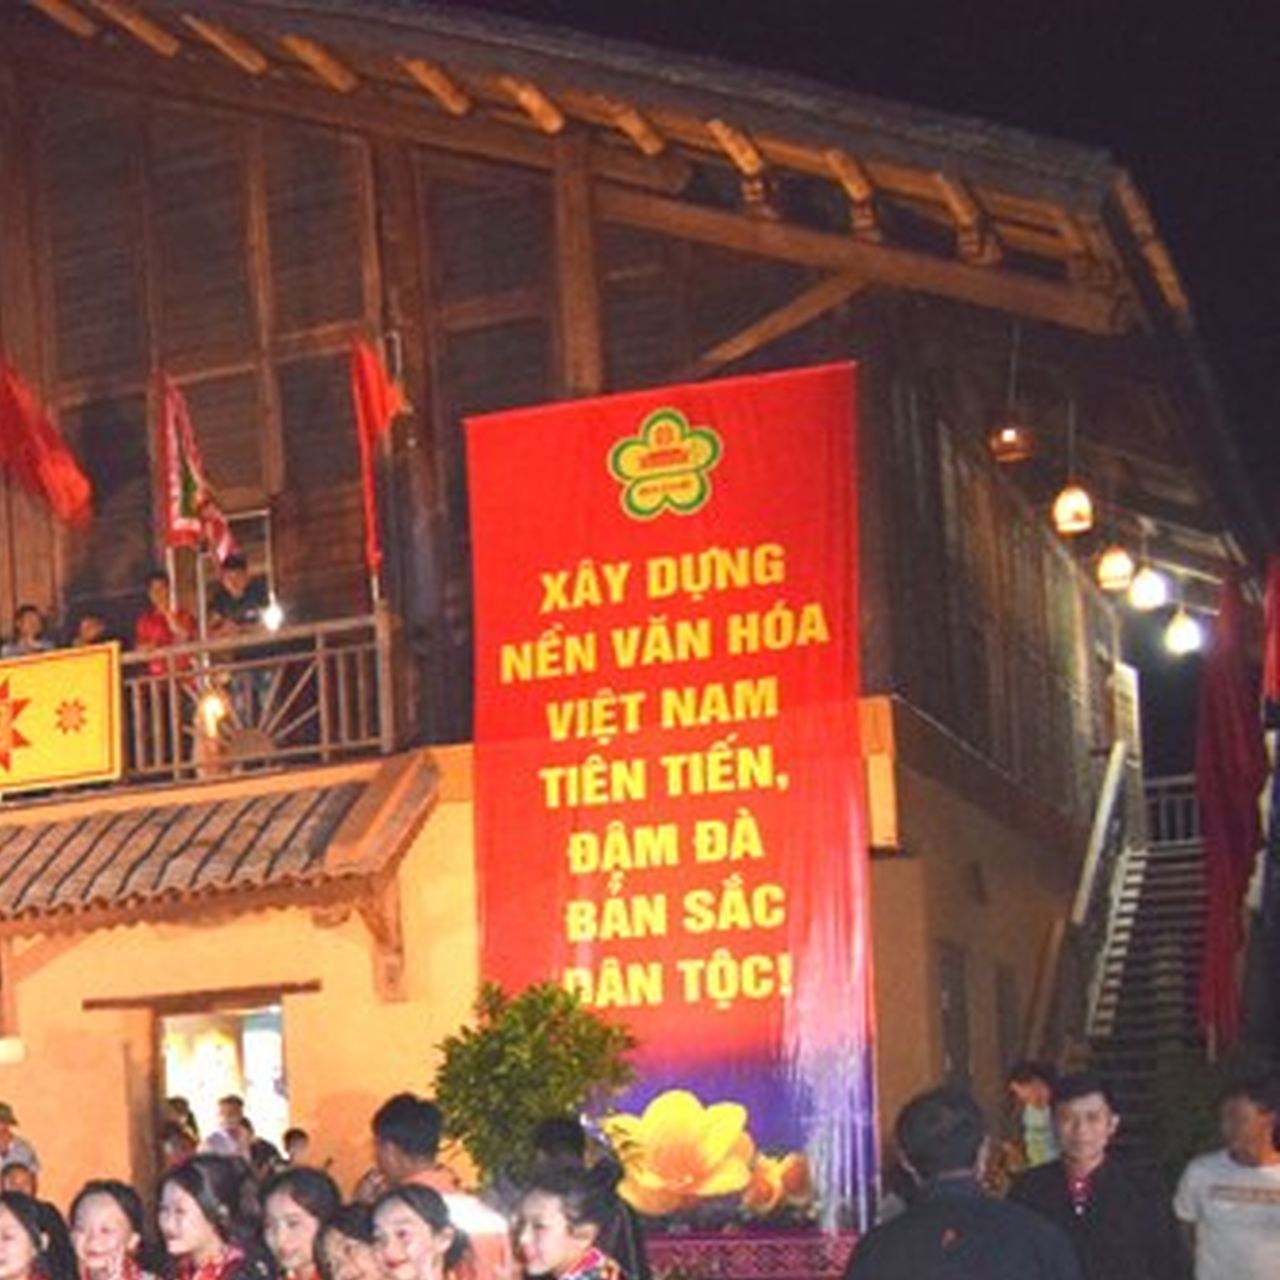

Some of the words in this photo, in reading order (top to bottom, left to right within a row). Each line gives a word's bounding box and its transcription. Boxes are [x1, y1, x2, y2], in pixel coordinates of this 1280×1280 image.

[540, 558, 631, 614] XÂY
[647, 543, 786, 602] DỰNG
[500, 622, 596, 684] NỀN
[611, 614, 711, 668] VĂN
[728, 599, 830, 655] HÓA
[546, 688, 646, 746] VIỆT
[661, 676, 778, 728] NAM
[539, 754, 646, 809] TIÊN
[660, 733, 789, 796] TIẾN,
[567, 820, 679, 877] ĐẬM
[694, 807, 765, 863] ĐÀ
[565, 878, 667, 943] BẢN
[683, 873, 785, 934] SẮC
[564, 957, 663, 1007] DÂN
[677, 947, 793, 1010] TỘC!
